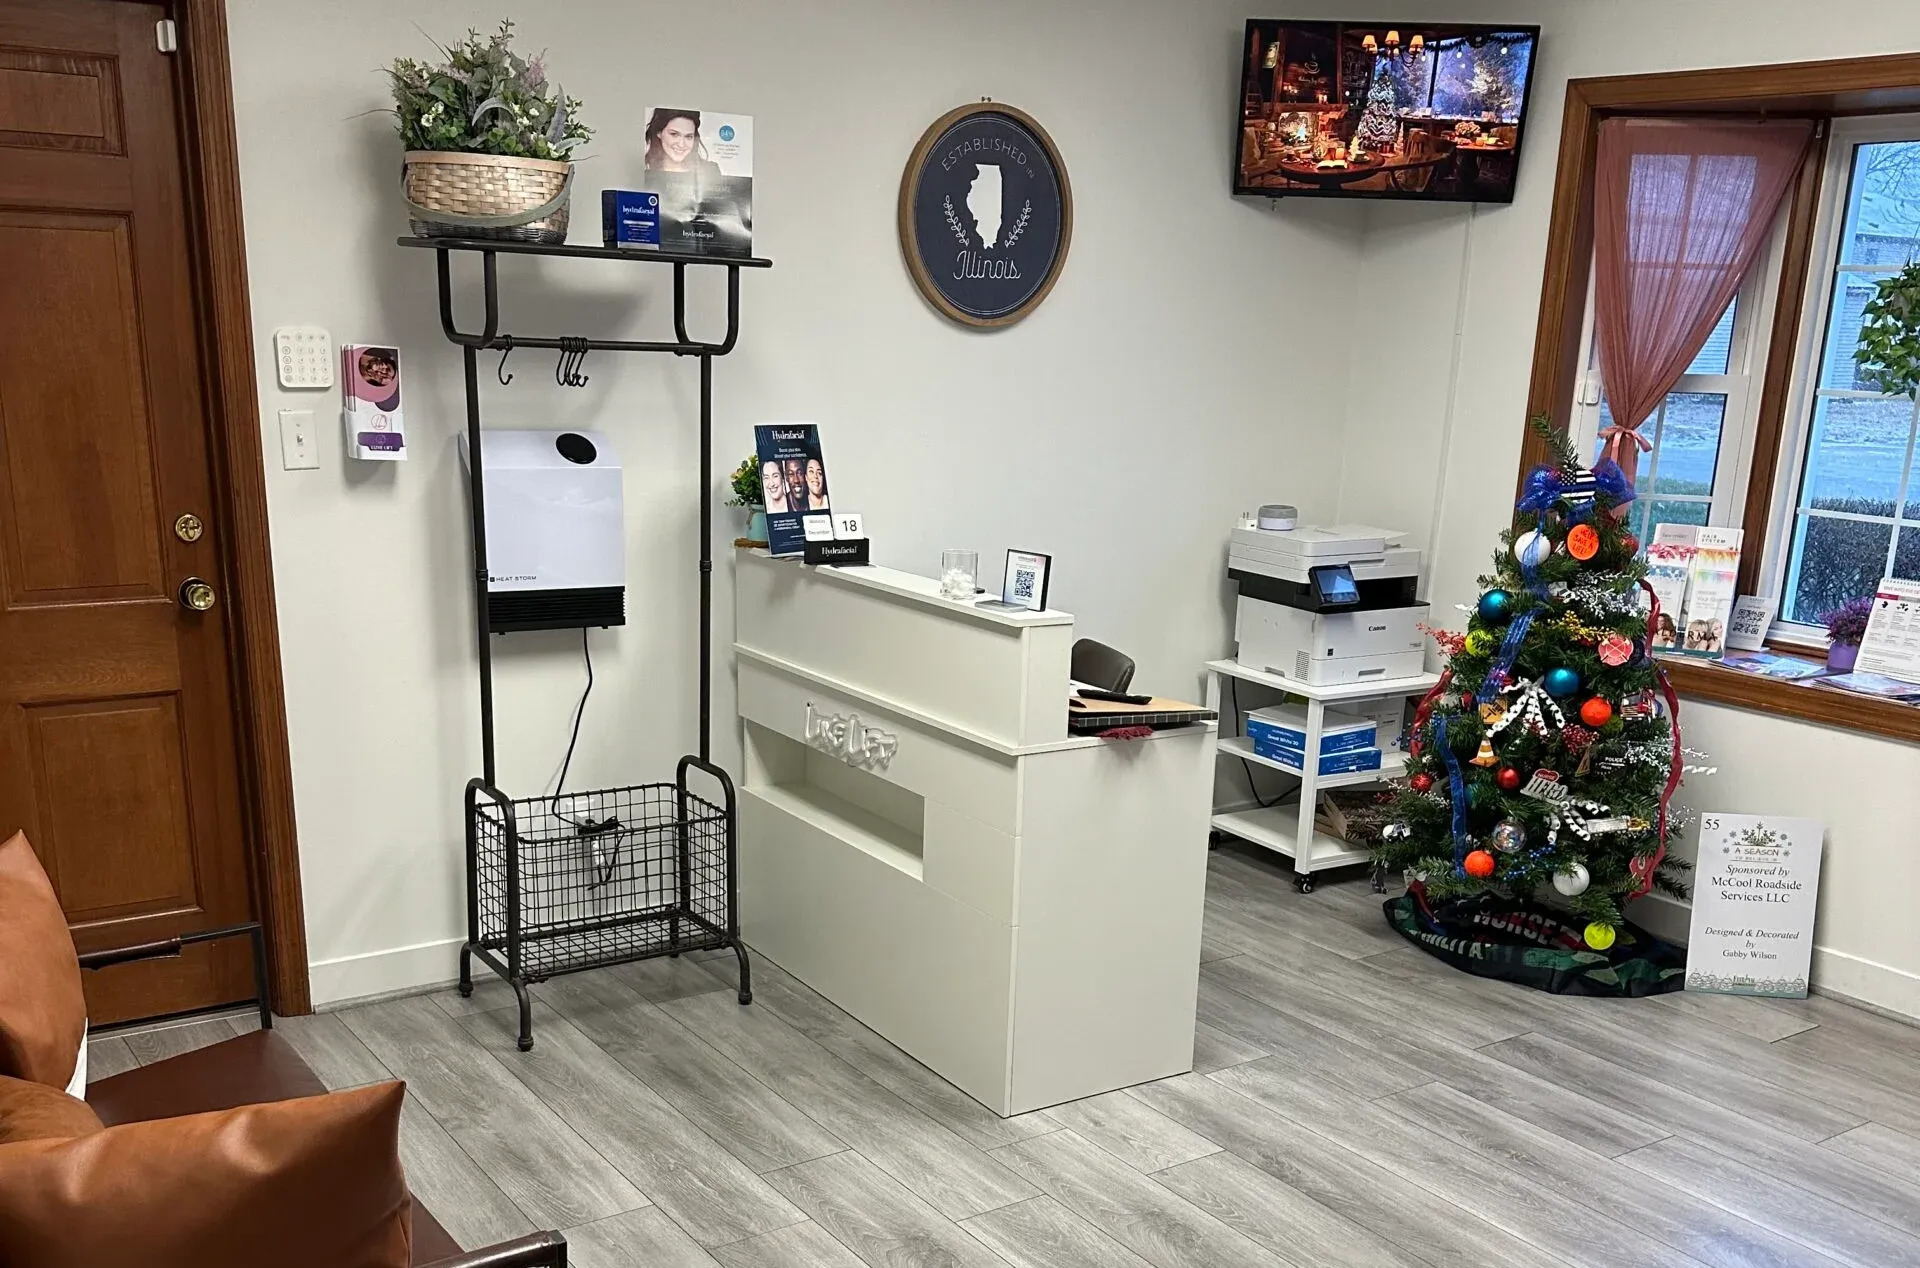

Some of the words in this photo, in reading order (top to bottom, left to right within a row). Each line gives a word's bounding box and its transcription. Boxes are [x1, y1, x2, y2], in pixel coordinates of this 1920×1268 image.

[941, 138, 1027, 171] ESTABLISHED
[1026, 167, 1035, 179] IN
[952, 250, 1021, 280] Illinois
[842, 520, 857, 532] 18
[821, 546, 857, 557] Hydrafacial
[1704, 818, 1720, 830] 55
[1744, 847, 1779, 856] SEASON
[1726, 864, 1776, 876] Sponsored
[1778, 866, 1790, 878] by
[1711, 876, 1752, 887] McCool
[1755, 879, 1802, 890] Roadside
[1720, 890, 1763, 902] Services
[1766, 893, 1790, 903] LLC
[1705, 926, 1744, 937] Designed
[1745, 929, 1753, 937] &
[1755, 929, 1799, 940] Decorated
[1745, 939, 1756, 949] by
[1722, 949, 1748, 960] Gabby
[1750, 950, 1777, 960] Wilson
